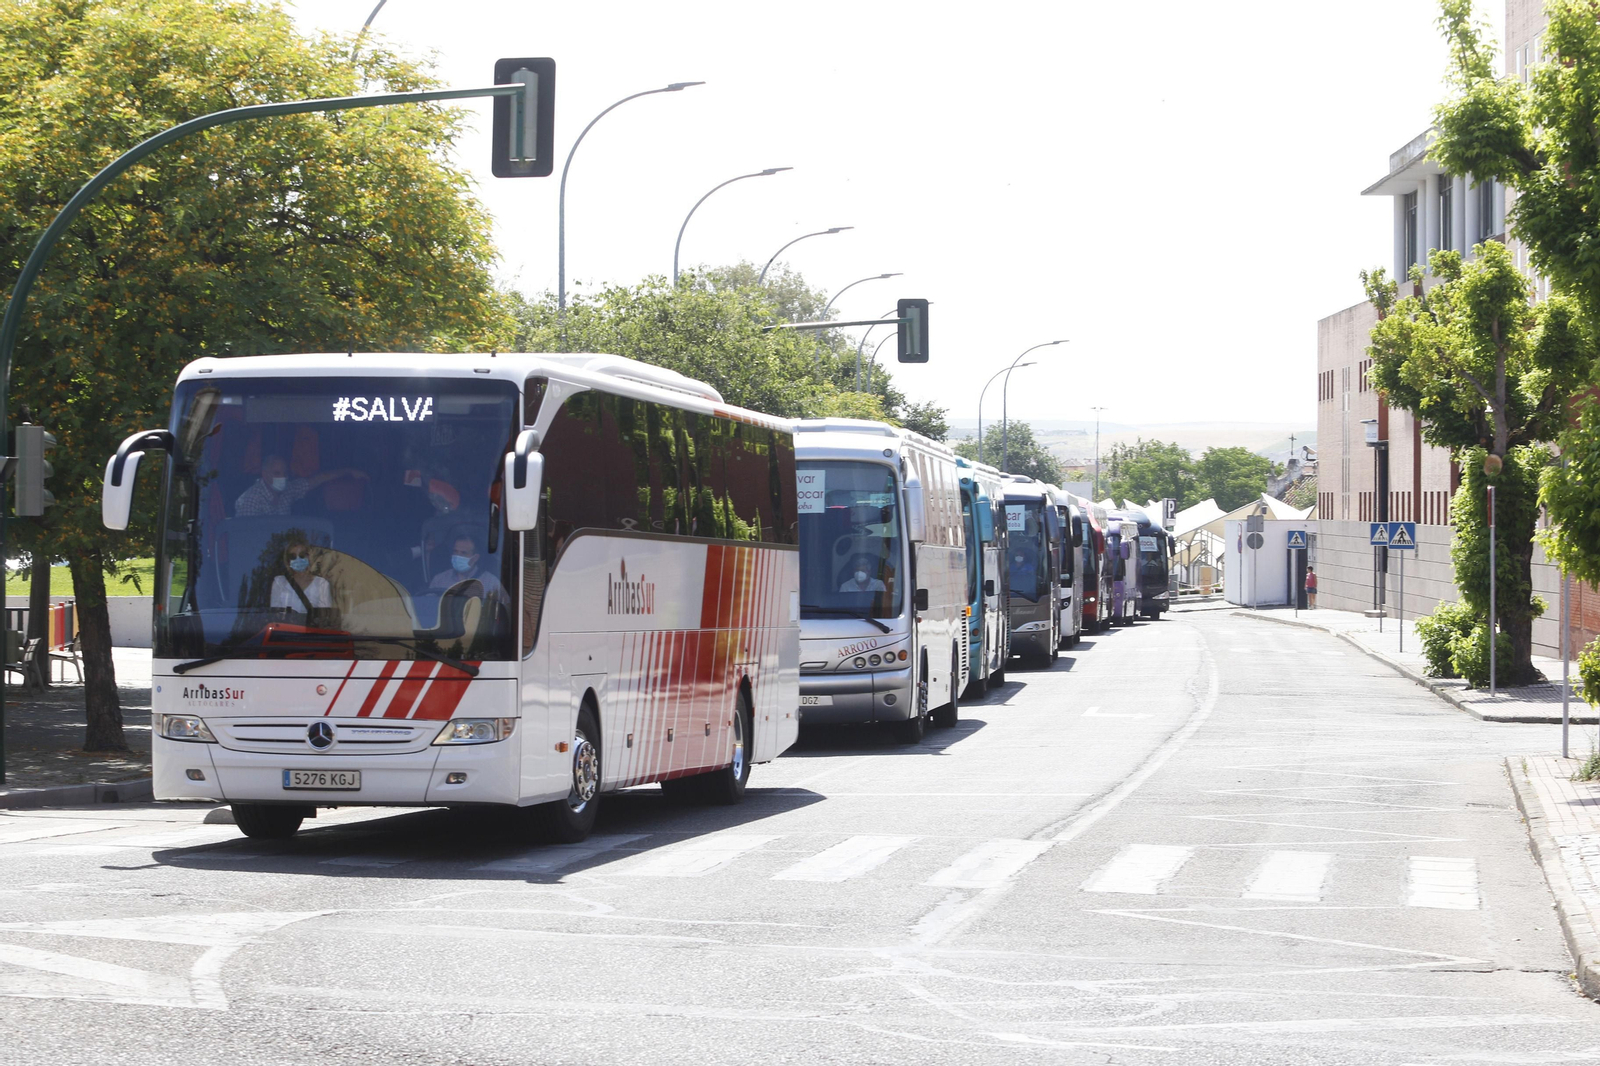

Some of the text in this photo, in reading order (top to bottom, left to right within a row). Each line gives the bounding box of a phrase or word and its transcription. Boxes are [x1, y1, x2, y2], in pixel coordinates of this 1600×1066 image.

[1168, 500, 1175, 518] P
[607, 556, 655, 615] ArribasSur
[837, 638, 878, 658] ARROYO
[183, 684, 245, 699] ArribasSur
[802, 696, 819, 705] DGZ
[294, 773, 355, 786] 5276 KGJ
